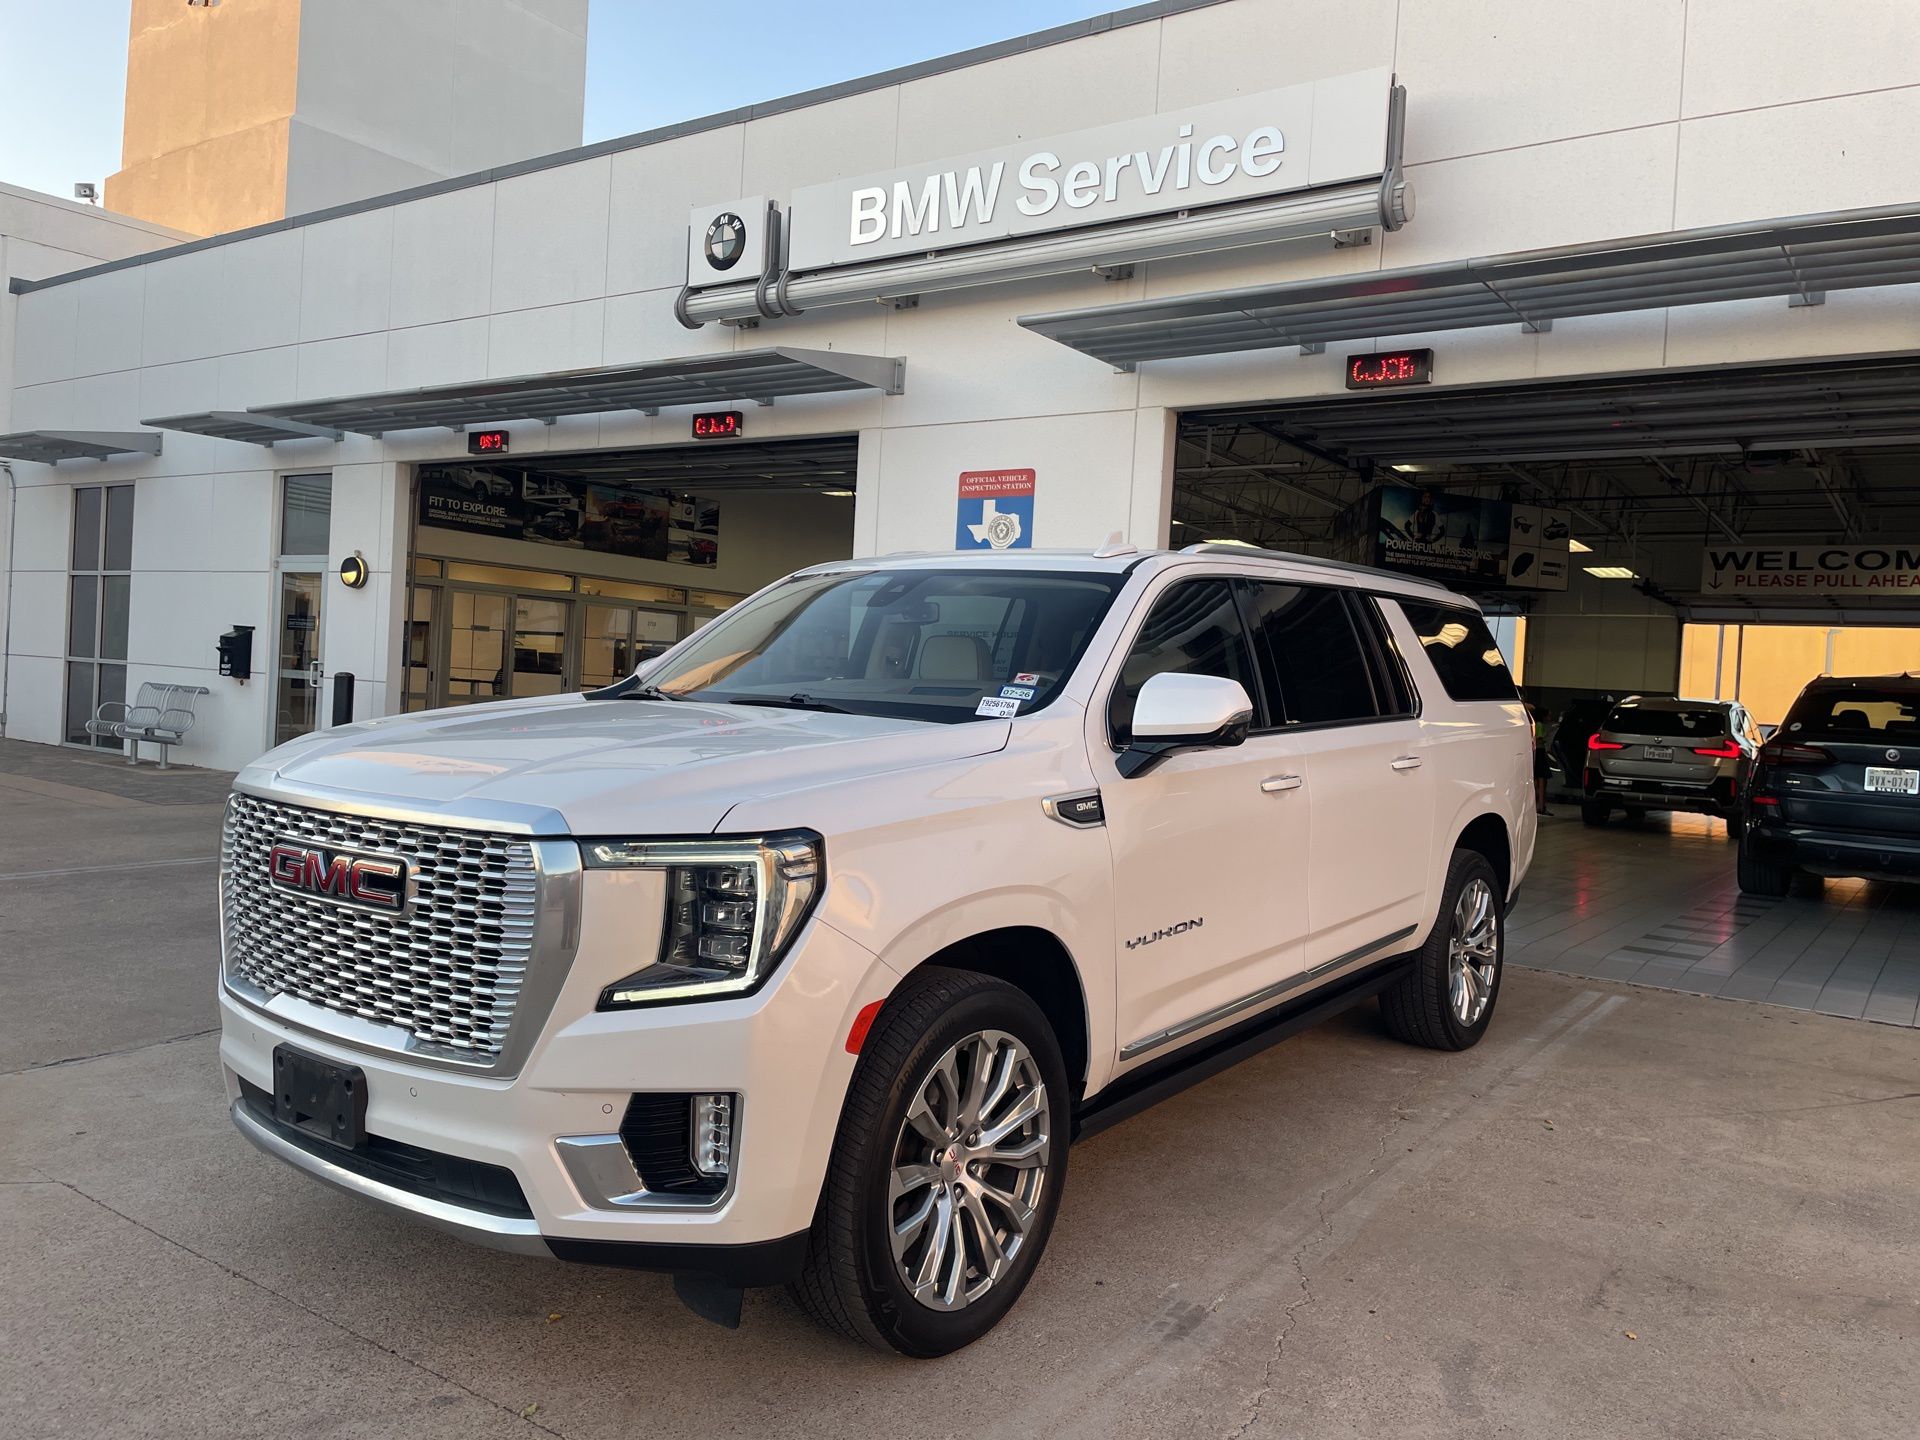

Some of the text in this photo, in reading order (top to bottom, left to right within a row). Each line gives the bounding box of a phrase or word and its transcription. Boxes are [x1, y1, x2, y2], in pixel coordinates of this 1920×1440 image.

[849, 122, 1285, 246] BMW Service
[961, 482, 1032, 492] INSPECTION STATION
[966, 474, 1028, 484] OFFICIAL VEHICLE
[429, 495, 508, 518] FIT TO EXPLORE.
[1385, 538, 1434, 554] POWERFUL
[1709, 550, 1920, 571] WELCOM
[1734, 574, 1920, 588] PLEASE PULL AHEA
[1869, 776, 1914, 788] RVX-0747
[1076, 801, 1098, 811] GMC
[270, 844, 400, 908] GMC
[1125, 917, 1203, 950] YUKON
